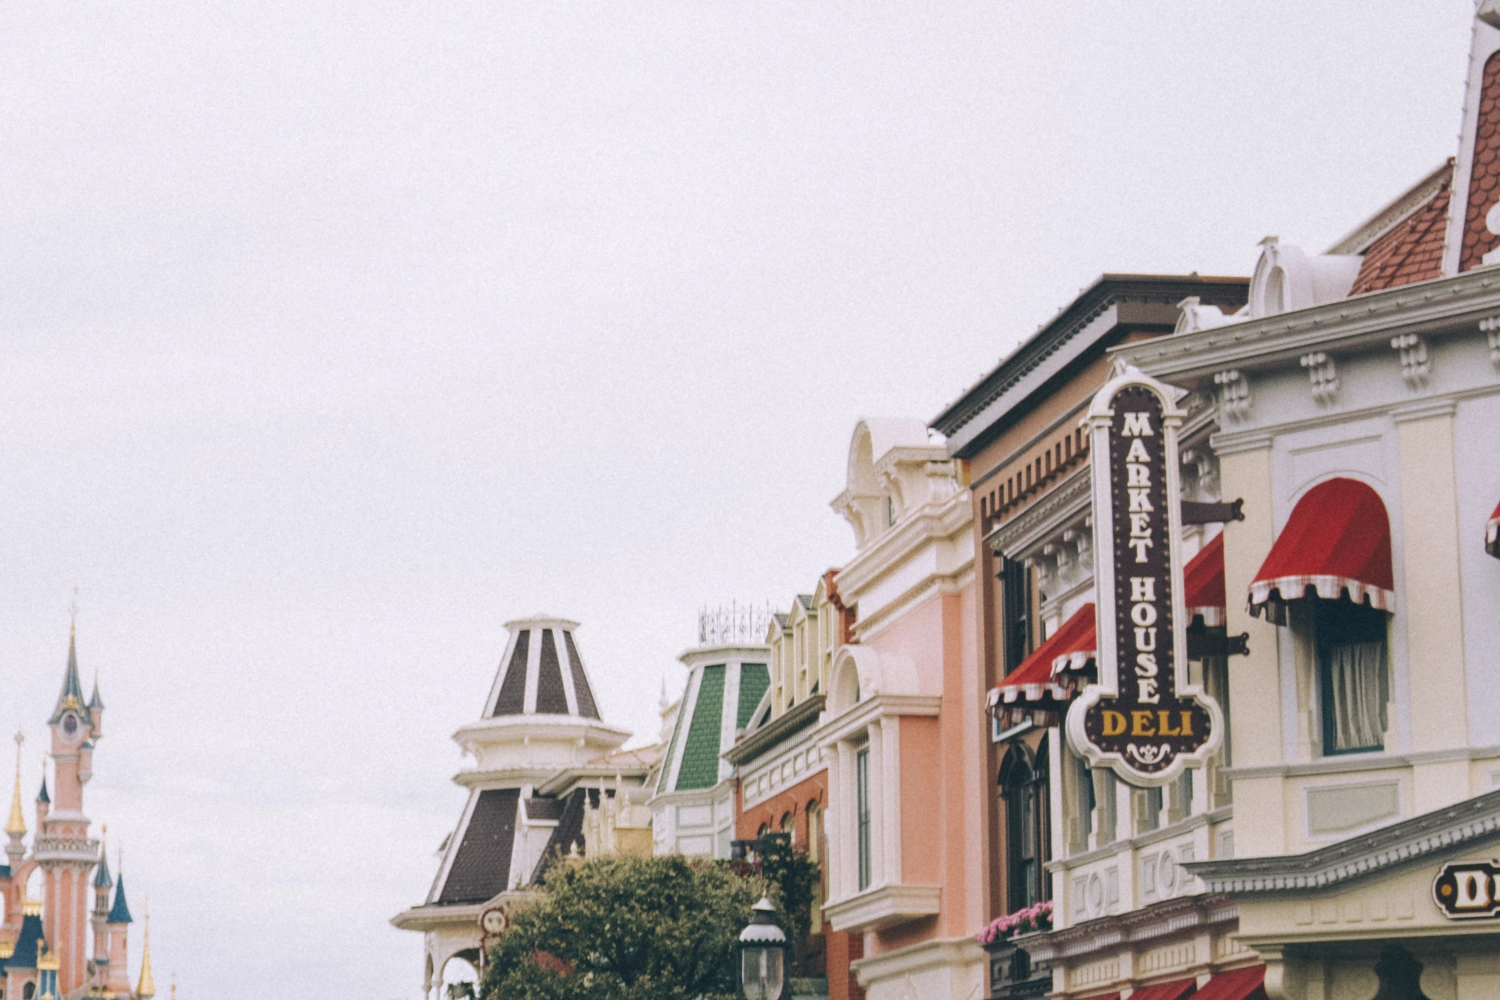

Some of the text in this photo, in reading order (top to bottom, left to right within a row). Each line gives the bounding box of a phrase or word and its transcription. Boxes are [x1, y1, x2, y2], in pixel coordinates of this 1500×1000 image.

[1121, 411, 1161, 704] MARKET HOUSE
[1101, 709, 1194, 738] DELI
